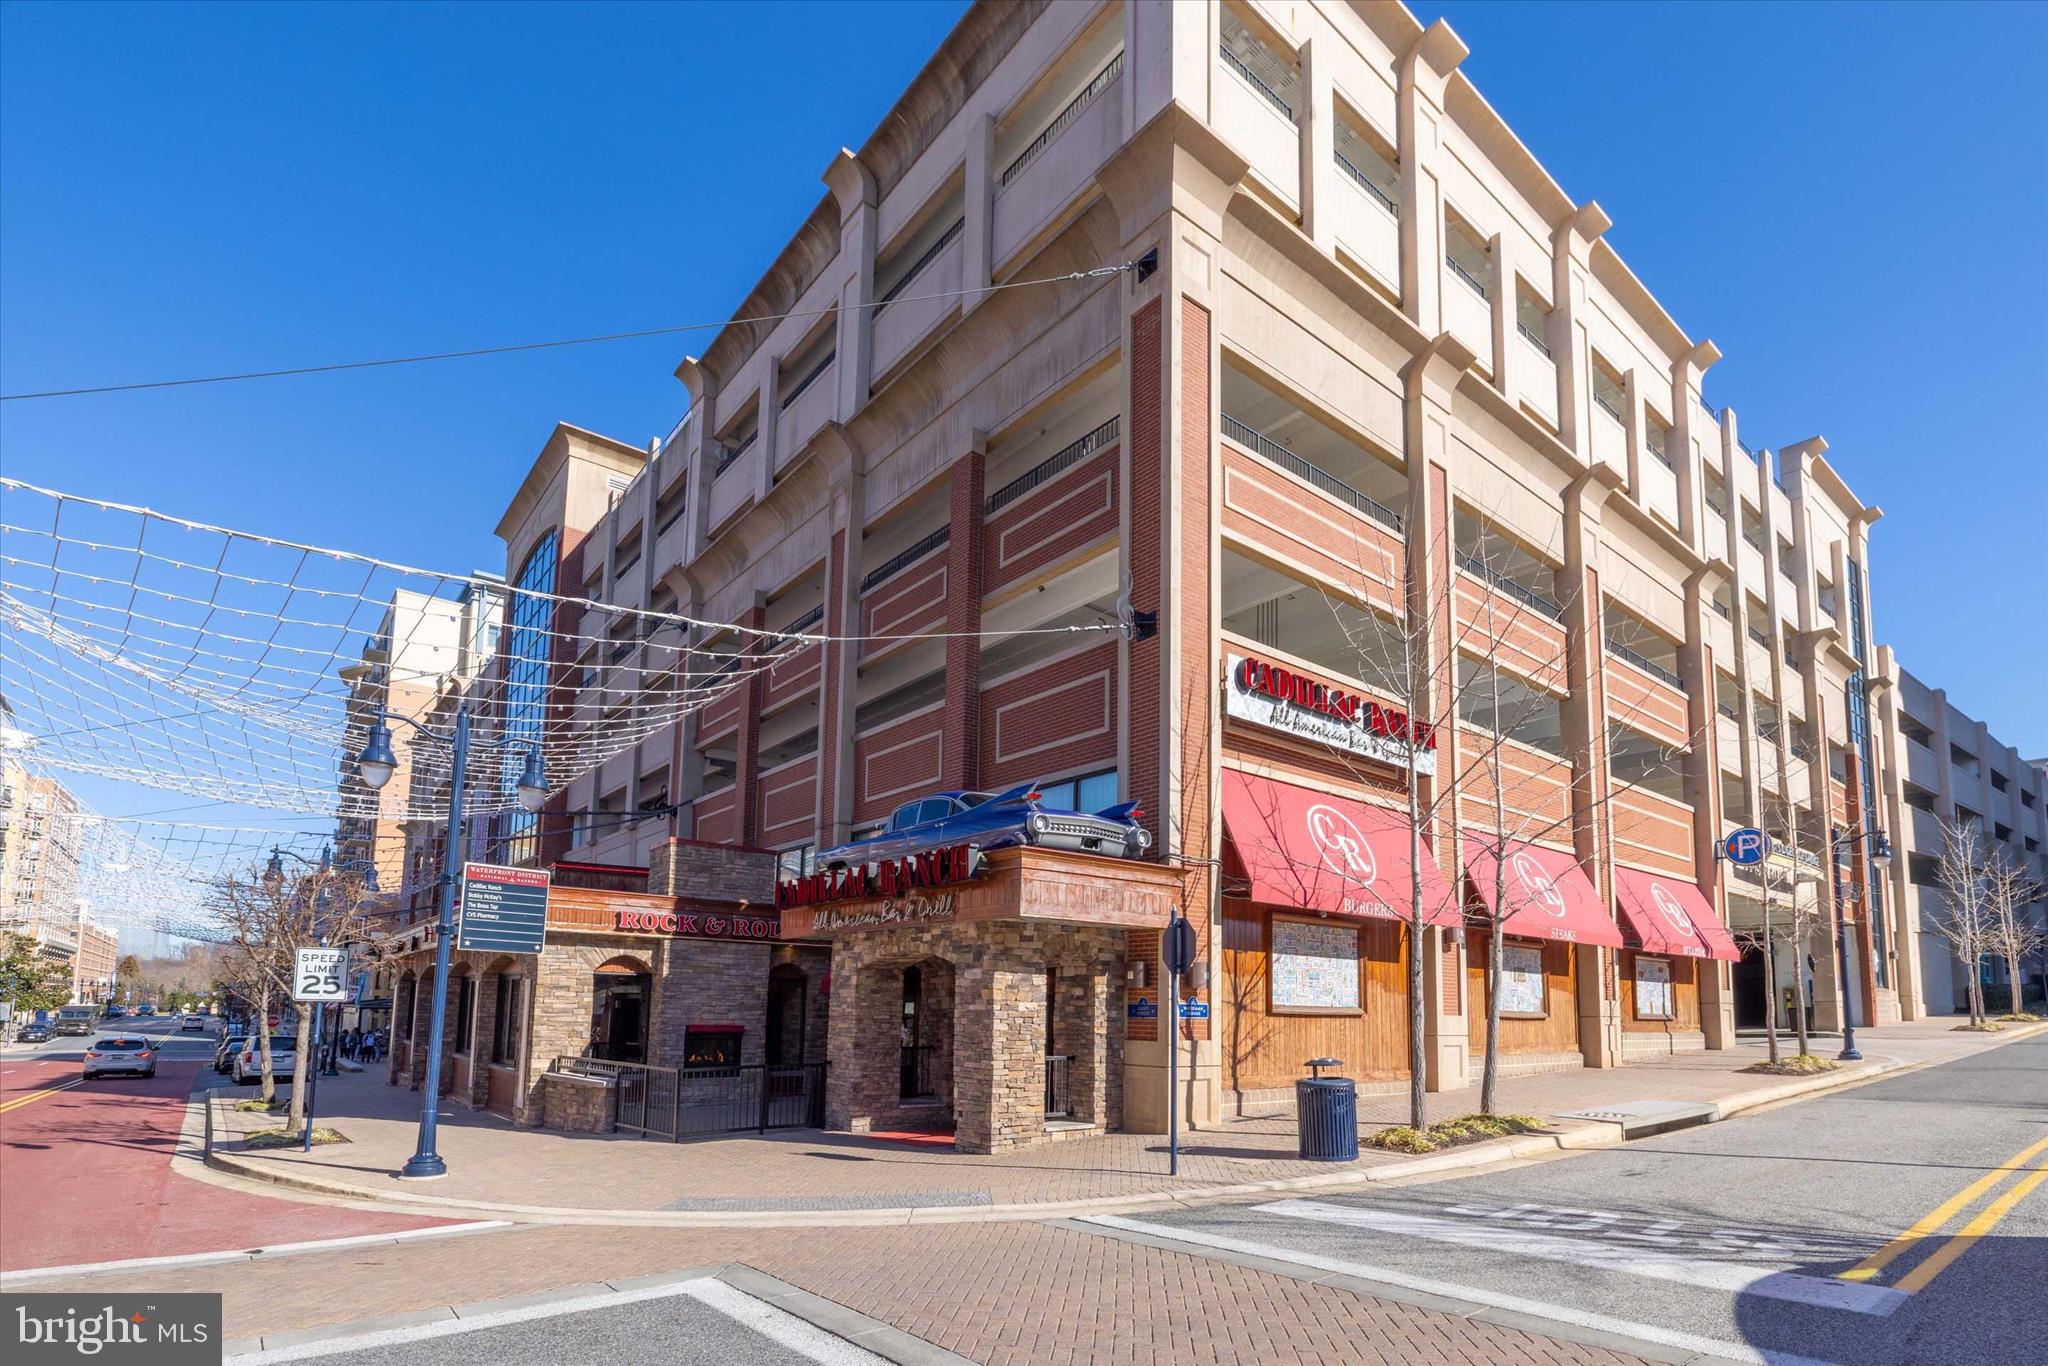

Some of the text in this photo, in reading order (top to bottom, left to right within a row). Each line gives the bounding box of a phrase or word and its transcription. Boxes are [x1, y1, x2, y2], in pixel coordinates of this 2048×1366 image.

[1234, 657, 1361, 723] CADILLAC
[470, 867, 547, 880] WATERFRONT DISTRICT
[879, 844, 971, 898] RANCH
[469, 882, 502, 891] Cadillac Ranch
[468, 892, 483, 900] Bobby
[467, 901, 475, 909] The
[490, 903, 498, 911] Tap
[1343, 897, 1394, 918] BURGERS
[477, 912, 499, 920] Pharmacy
[813, 911, 828, 931] All
[881, 900, 901, 923] Bar
[917, 894, 953, 922] Grill
[620, 911, 781, 939] ROCK & ROL
[1550, 928, 1577, 940] STEAKS
[301, 953, 345, 963] SPEED
[305, 965, 340, 973] LIMIT
[301, 975, 341, 995] 25
